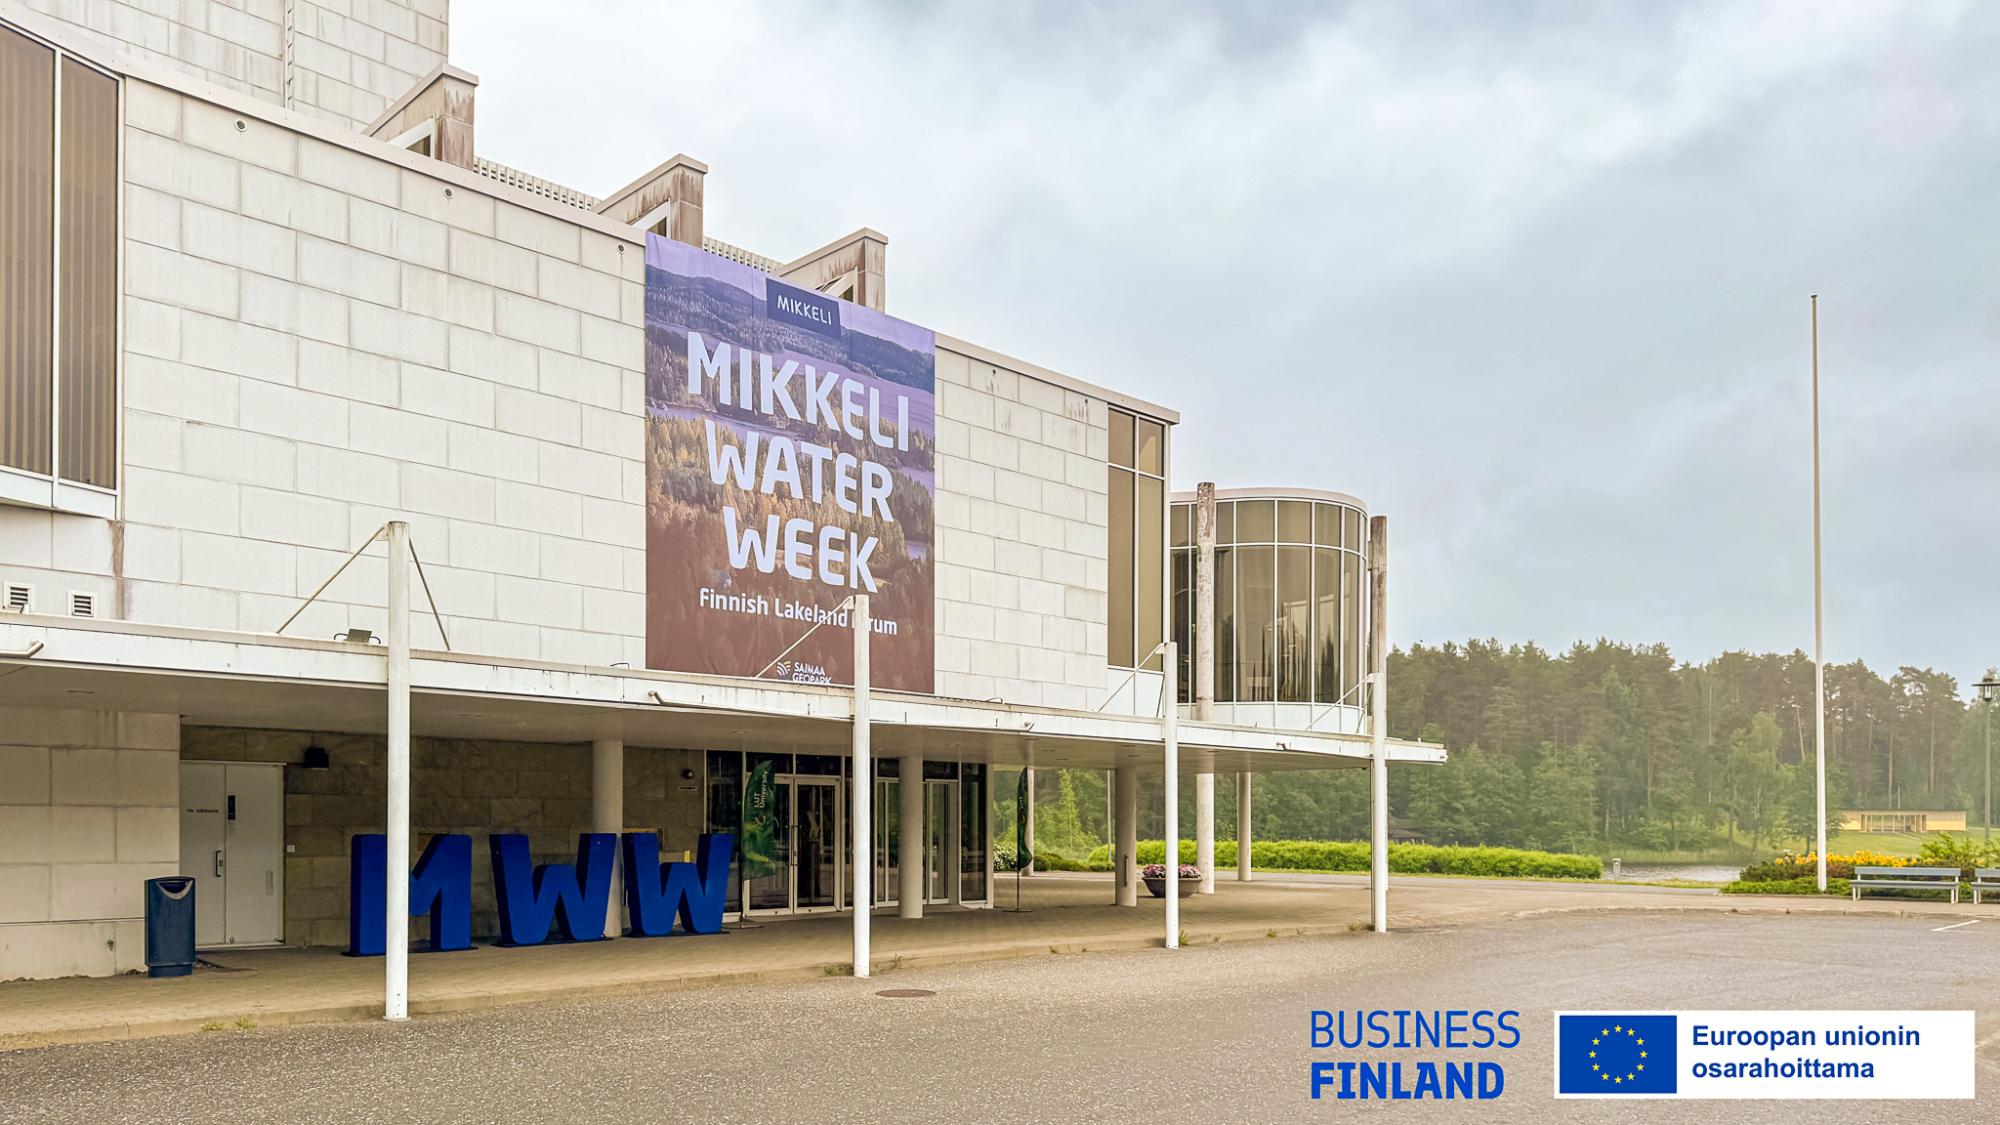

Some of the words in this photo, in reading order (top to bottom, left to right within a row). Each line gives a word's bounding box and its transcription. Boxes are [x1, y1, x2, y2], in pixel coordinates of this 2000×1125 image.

[777, 294, 832, 325] MIKKELI
[687, 331, 909, 452] MIKKELI
[705, 419, 894, 523] WATER
[722, 505, 879, 593] WEEK
[700, 587, 769, 616] Finnish
[774, 597, 848, 628] Lakeland
[792, 672, 832, 685] GEOPARK
[794, 661, 826, 677] SAIMAA
